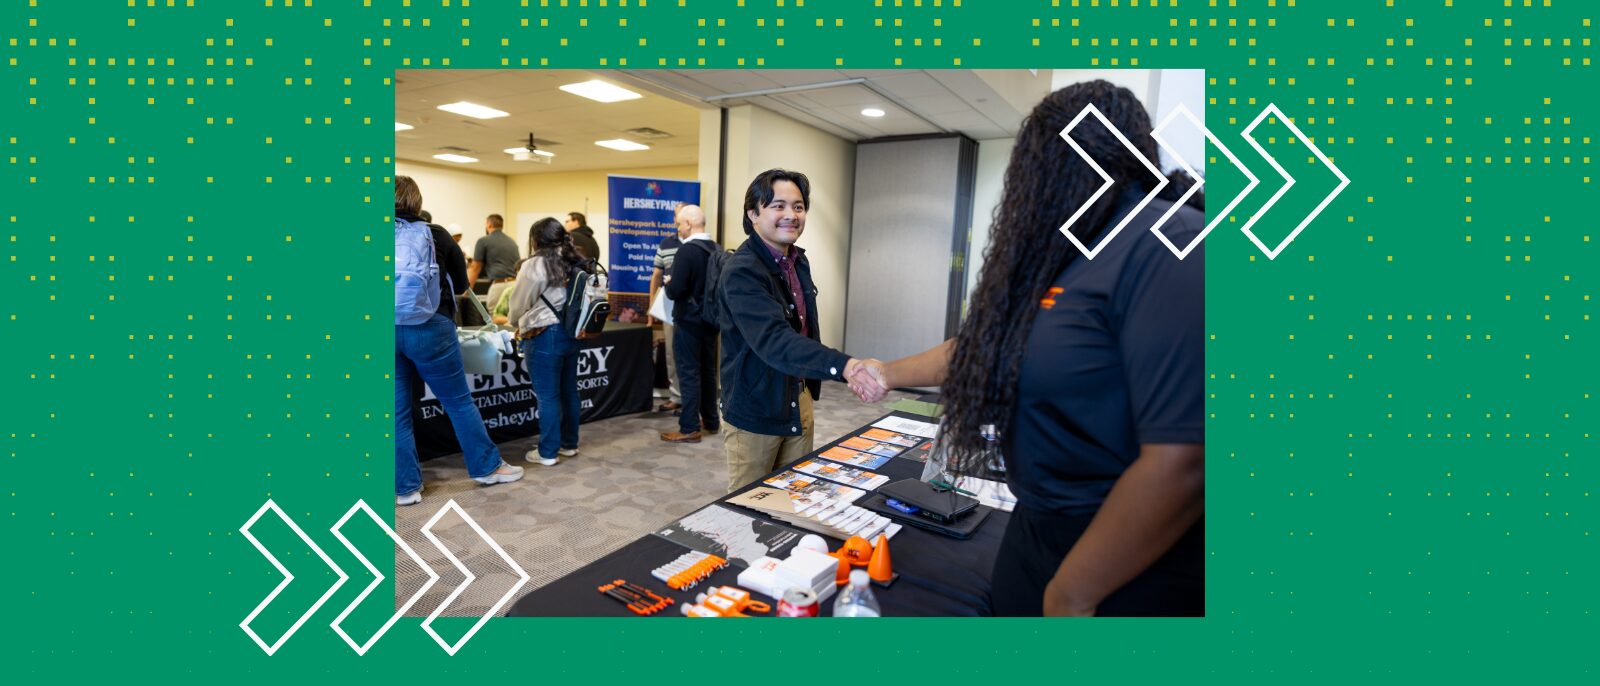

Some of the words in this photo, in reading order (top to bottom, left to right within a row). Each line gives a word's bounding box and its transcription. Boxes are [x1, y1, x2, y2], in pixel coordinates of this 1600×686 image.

[623, 197, 683, 211] HERSHEYPAR
[609, 218, 656, 228] Hersheypark
[609, 227, 659, 236] Development
[623, 242, 641, 250] Open
[611, 264, 638, 272] Housing
